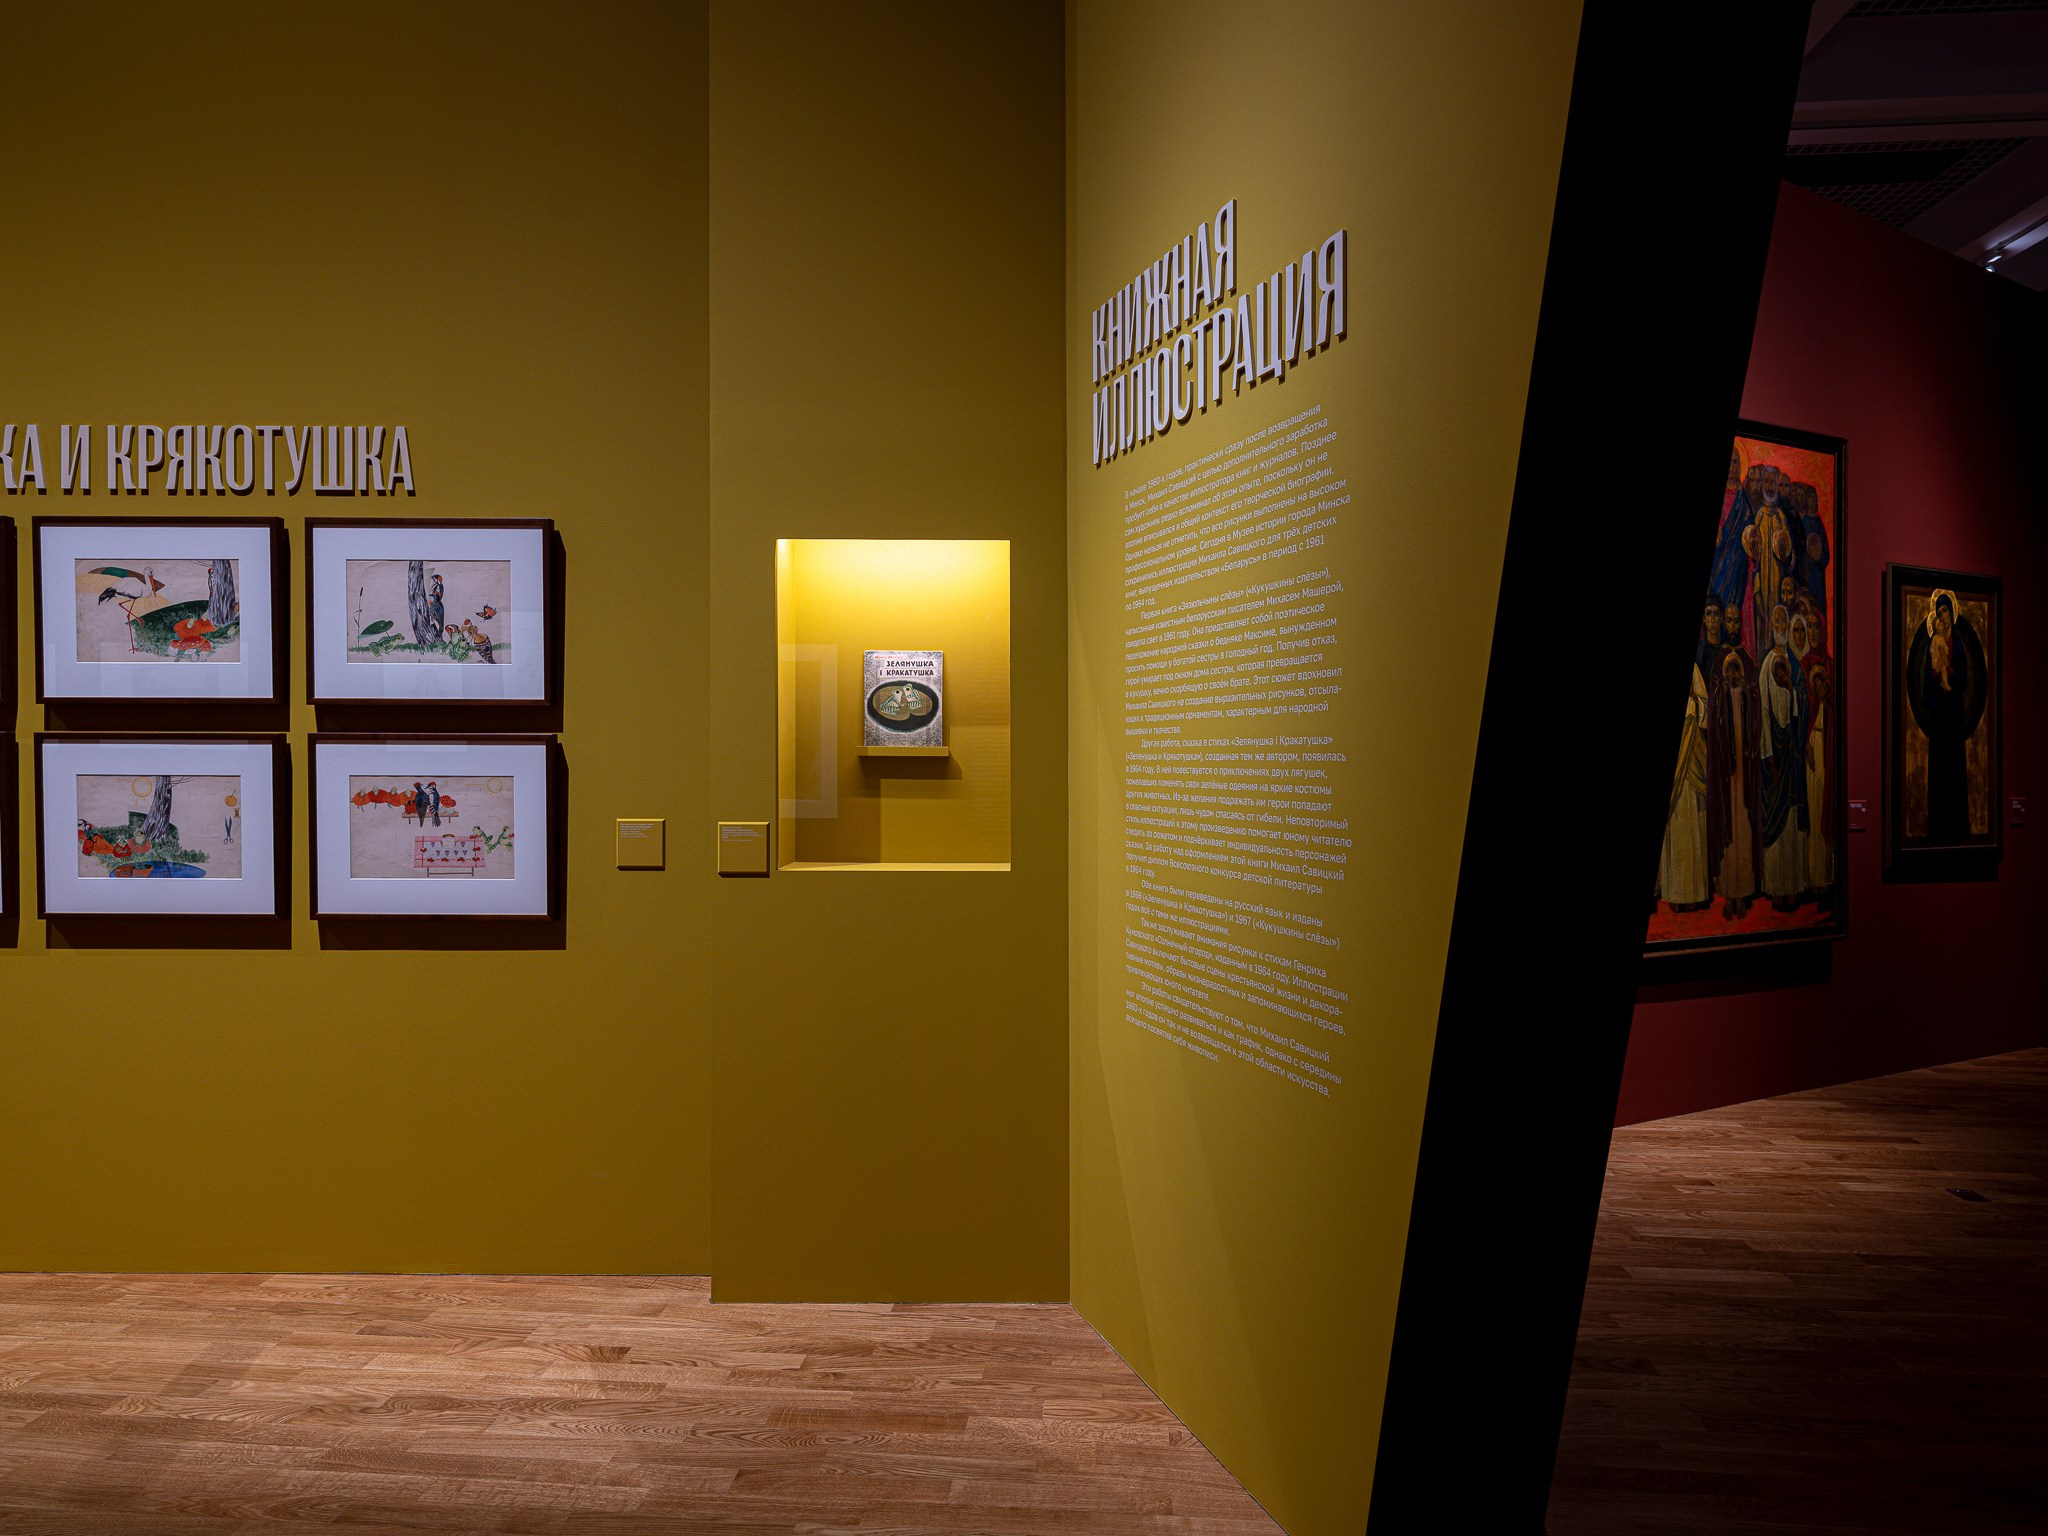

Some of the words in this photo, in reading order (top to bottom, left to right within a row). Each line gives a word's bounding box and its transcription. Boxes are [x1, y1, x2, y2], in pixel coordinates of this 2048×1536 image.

[1093, 198, 1236, 384] КНИЖНАЯ
[1093, 228, 1347, 466] ИЛЛЮСТРАЦИЯ
[1246, 429, 1267, 446] после
[1268, 404, 1321, 436] возвращения
[60, 424, 91, 490] И
[107, 424, 415, 492] КРЯКОТУШКА
[1223, 436, 1284, 472] дополнительного
[1286, 417, 1328, 444] заработка
[1236, 466, 1252, 480] книг
[1301, 430, 1337, 454] Позднее
[1264, 460, 1304, 484] поскольку
[1305, 456, 1316, 468] он
[1318, 451, 1328, 463] не
[1244, 481, 1286, 507] творческой
[1288, 466, 1334, 491] биографии.
[1254, 496, 1296, 518] выполнены
[1298, 492, 1308, 503] на
[1309, 478, 1346, 499] высоком
[1233, 525, 1254, 541] Музее
[1256, 515, 1287, 533] истории
[1288, 505, 1316, 523] города
[1318, 494, 1351, 513] Минска
[1228, 537, 1266, 556] Савицкого
[1267, 532, 1281, 547] для
[1283, 525, 1301, 541] трёх
[1302, 515, 1337, 536] детских
[1269, 543, 1298, 560] период
[1299, 542, 1304, 551] с
[1306, 534, 1324, 549] 1961
[1228, 599, 1265, 615] писателем
[1266, 591, 1300, 607] Михасем
[1302, 579, 1344, 599] Машерой,
[1246, 576, 1295, 598] («Кукушкины
[1296, 566, 1331, 584] слёзы»),
[1251, 610, 1273, 625] собой
[1275, 602, 1325, 621] поэтическое
[1279, 617, 1337, 636] вынужденном
[1226, 644, 1259, 659] голодный
[1277, 638, 1310, 652] Получив
[1312, 634, 1337, 646] отказ,
[1237, 661, 1265, 673] которая
[1266, 653, 1323, 671] превращается
[1253, 675, 1270, 685] Этот
[1272, 672, 1296, 683] сюжет
[1298, 667, 1342, 682] вдохновил
[1226, 706, 1272, 719] характерным
[1273, 705, 1288, 716] для
[1289, 700, 1329, 716] народной
[1268, 688, 1306, 702] рисунков,
[1308, 685, 1342, 696] отсыла-
[1231, 737, 1274, 748] «Зелянушка
[1280, 735, 1333, 748] Кракатушка»
[1219, 767, 1270, 778] приключениях
[1271, 768, 1289, 780] двух
[1291, 769, 1328, 780] лягушек,
[1240, 753, 1253, 761] тем
[1255, 753, 1265, 761] же
[1266, 753, 1300, 764] автором,
[1302, 753, 1346, 762] появилась
[1229, 782, 1258, 792] одеяния
[1260, 783, 1269, 792] на
[1270, 784, 1293, 795] яркие
[1295, 785, 1332, 795] костюмы
[1246, 813, 1255, 822] от
[1286, 814, 1348, 831] Неповторимый
[1256, 799, 1266, 807] им
[1268, 799, 1290, 811] герои
[1292, 801, 1332, 813] попадают
[1227, 840, 1294, 857] индивидуальность
[1295, 849, 1346, 865] персонажей
[1248, 828, 1282, 840] помогает
[1284, 832, 1310, 846] юному
[1312, 835, 1352, 848] читателю
[1243, 872, 1273, 885] детской
[1274, 877, 1323, 896] литературы
[1248, 858, 1269, 869] книги
[1271, 860, 1300, 874] Михаил
[1302, 864, 1344, 881] Савицкий
[1234, 900, 1264, 915] русский
[1265, 907, 1284, 919] язык
[1285, 911, 1291, 921] и
[1292, 913, 1323, 928] изданы
[1235, 913, 1251, 927] 1967
[1253, 917, 1304, 940] («Кукушкины
[1306, 931, 1340, 950] слёзы»)
[1229, 943, 1257, 959] рисунки
[1265, 953, 1292, 969] стихам
[1294, 959, 1326, 979] Генриха
[1228, 972, 1275, 995] крестьянской
[1277, 987, 1301, 1004] жизни
[1303, 996, 1308, 1006] и
[1310, 998, 1343, 1018] декора-
[1255, 963, 1271, 978] 1964
[1272, 970, 1291, 986] году.
[1293, 975, 1348, 1002] Иллюстрации
[1247, 993, 1312, 1024] запоминающихся
[1314, 1016, 1345, 1037] героев,
[1246, 1023, 1259, 1035] что
[1260, 1026, 1288, 1047] Михаил
[1290, 1038, 1330, 1063] Савицкий
[1238, 1049, 1254, 1064] этой
[1256, 1056, 1285, 1078] области
[1287, 1070, 1330, 1099] искусства,
[1265, 1045, 1292, 1065] однако
[1294, 1057, 1298, 1067] с
[1300, 1060, 1342, 1085] середины
